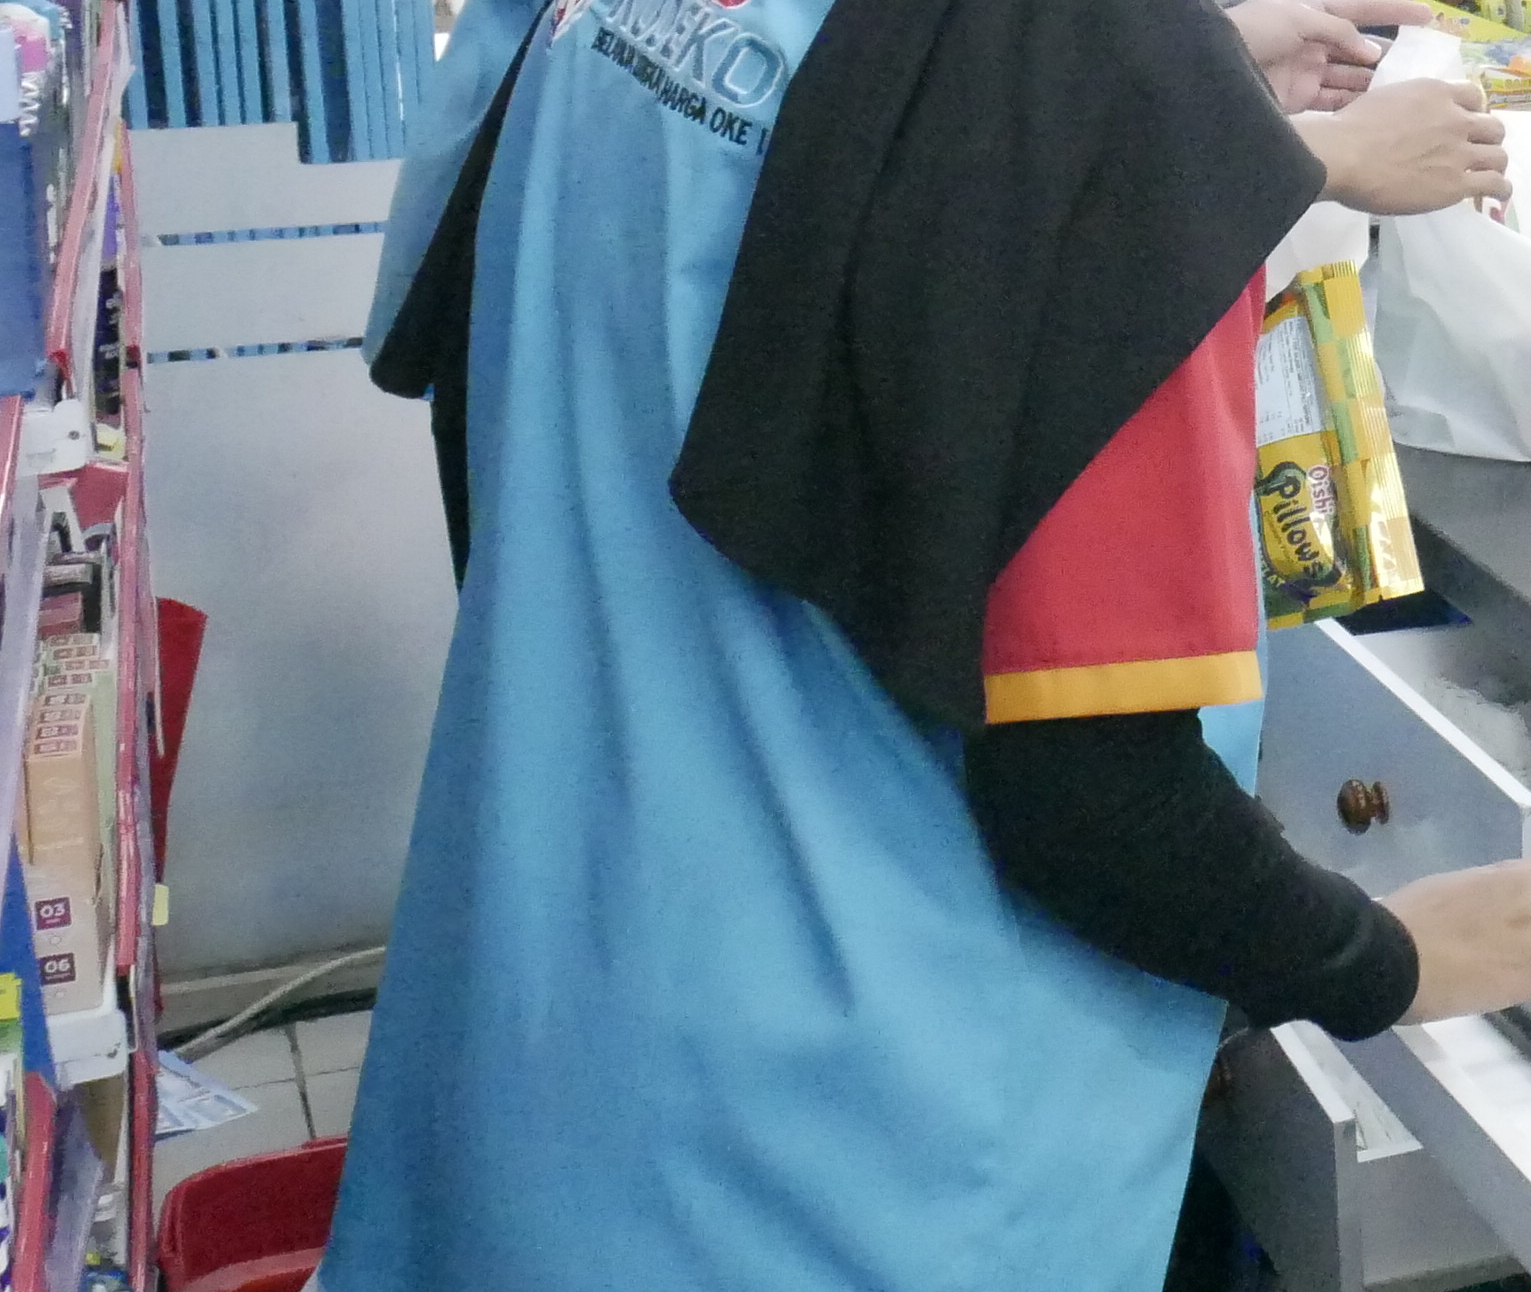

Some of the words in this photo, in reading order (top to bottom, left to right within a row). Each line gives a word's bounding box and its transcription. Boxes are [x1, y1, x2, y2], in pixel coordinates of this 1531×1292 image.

[709, 108, 754, 146] OKE
[1307, 464, 1334, 516] Oishi
[40, 902, 66, 918] 03
[45, 958, 71, 974] 06
